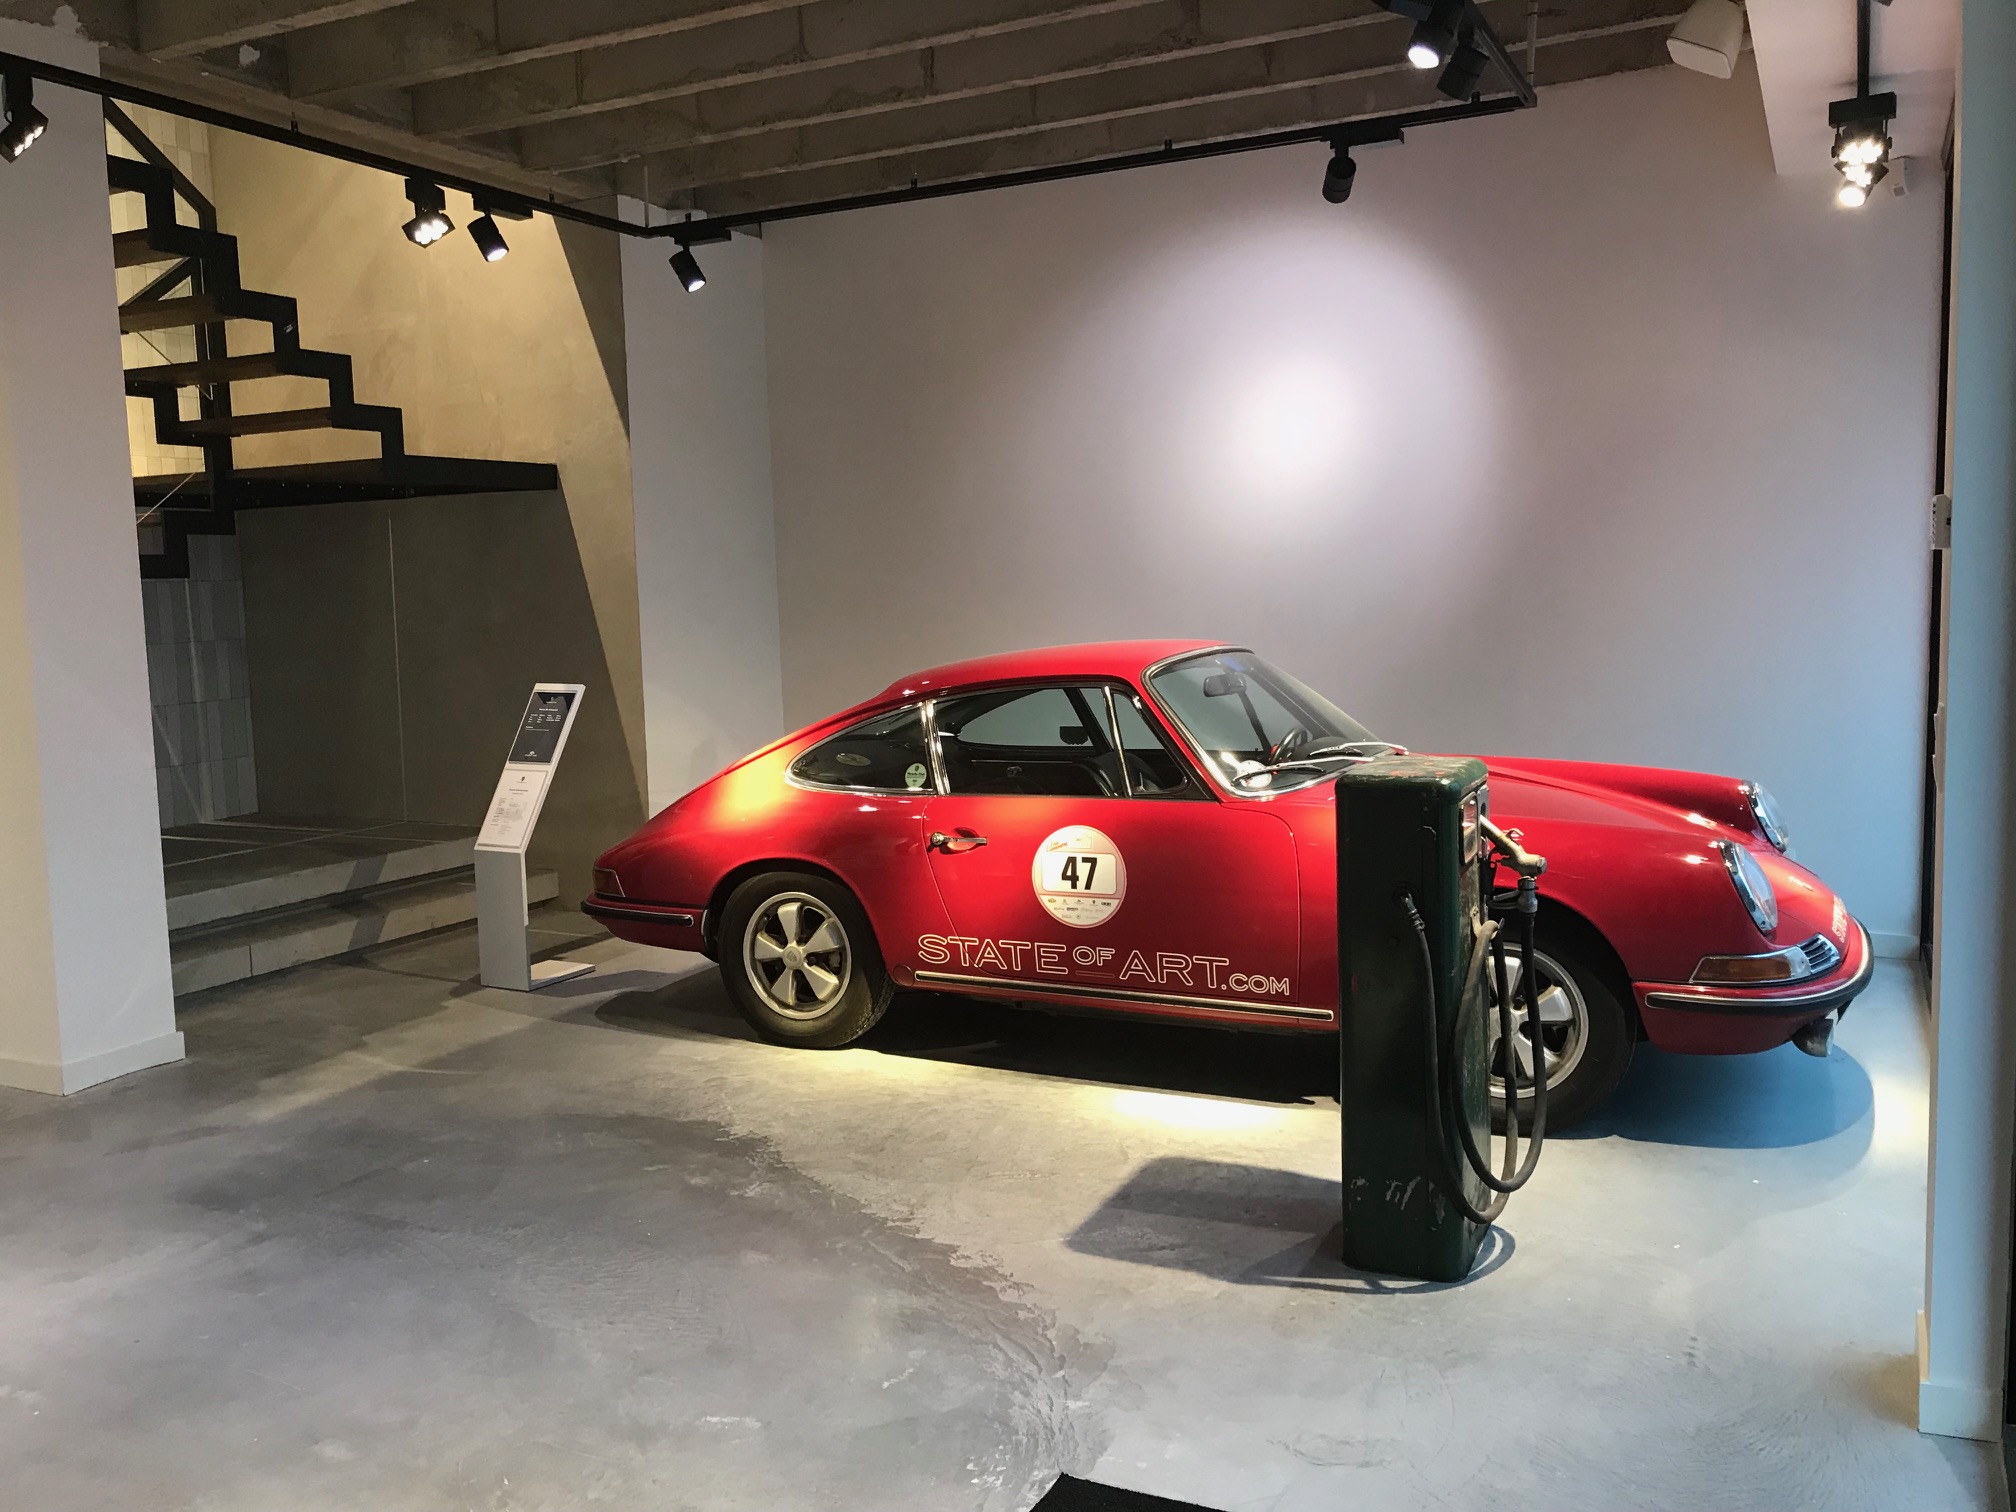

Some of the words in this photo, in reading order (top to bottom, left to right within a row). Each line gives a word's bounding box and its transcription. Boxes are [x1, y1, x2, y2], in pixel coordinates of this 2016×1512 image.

[1061, 856, 1098, 890] 47
[918, 934, 1069, 974] STATE
[1073, 946, 1115, 966] OF
